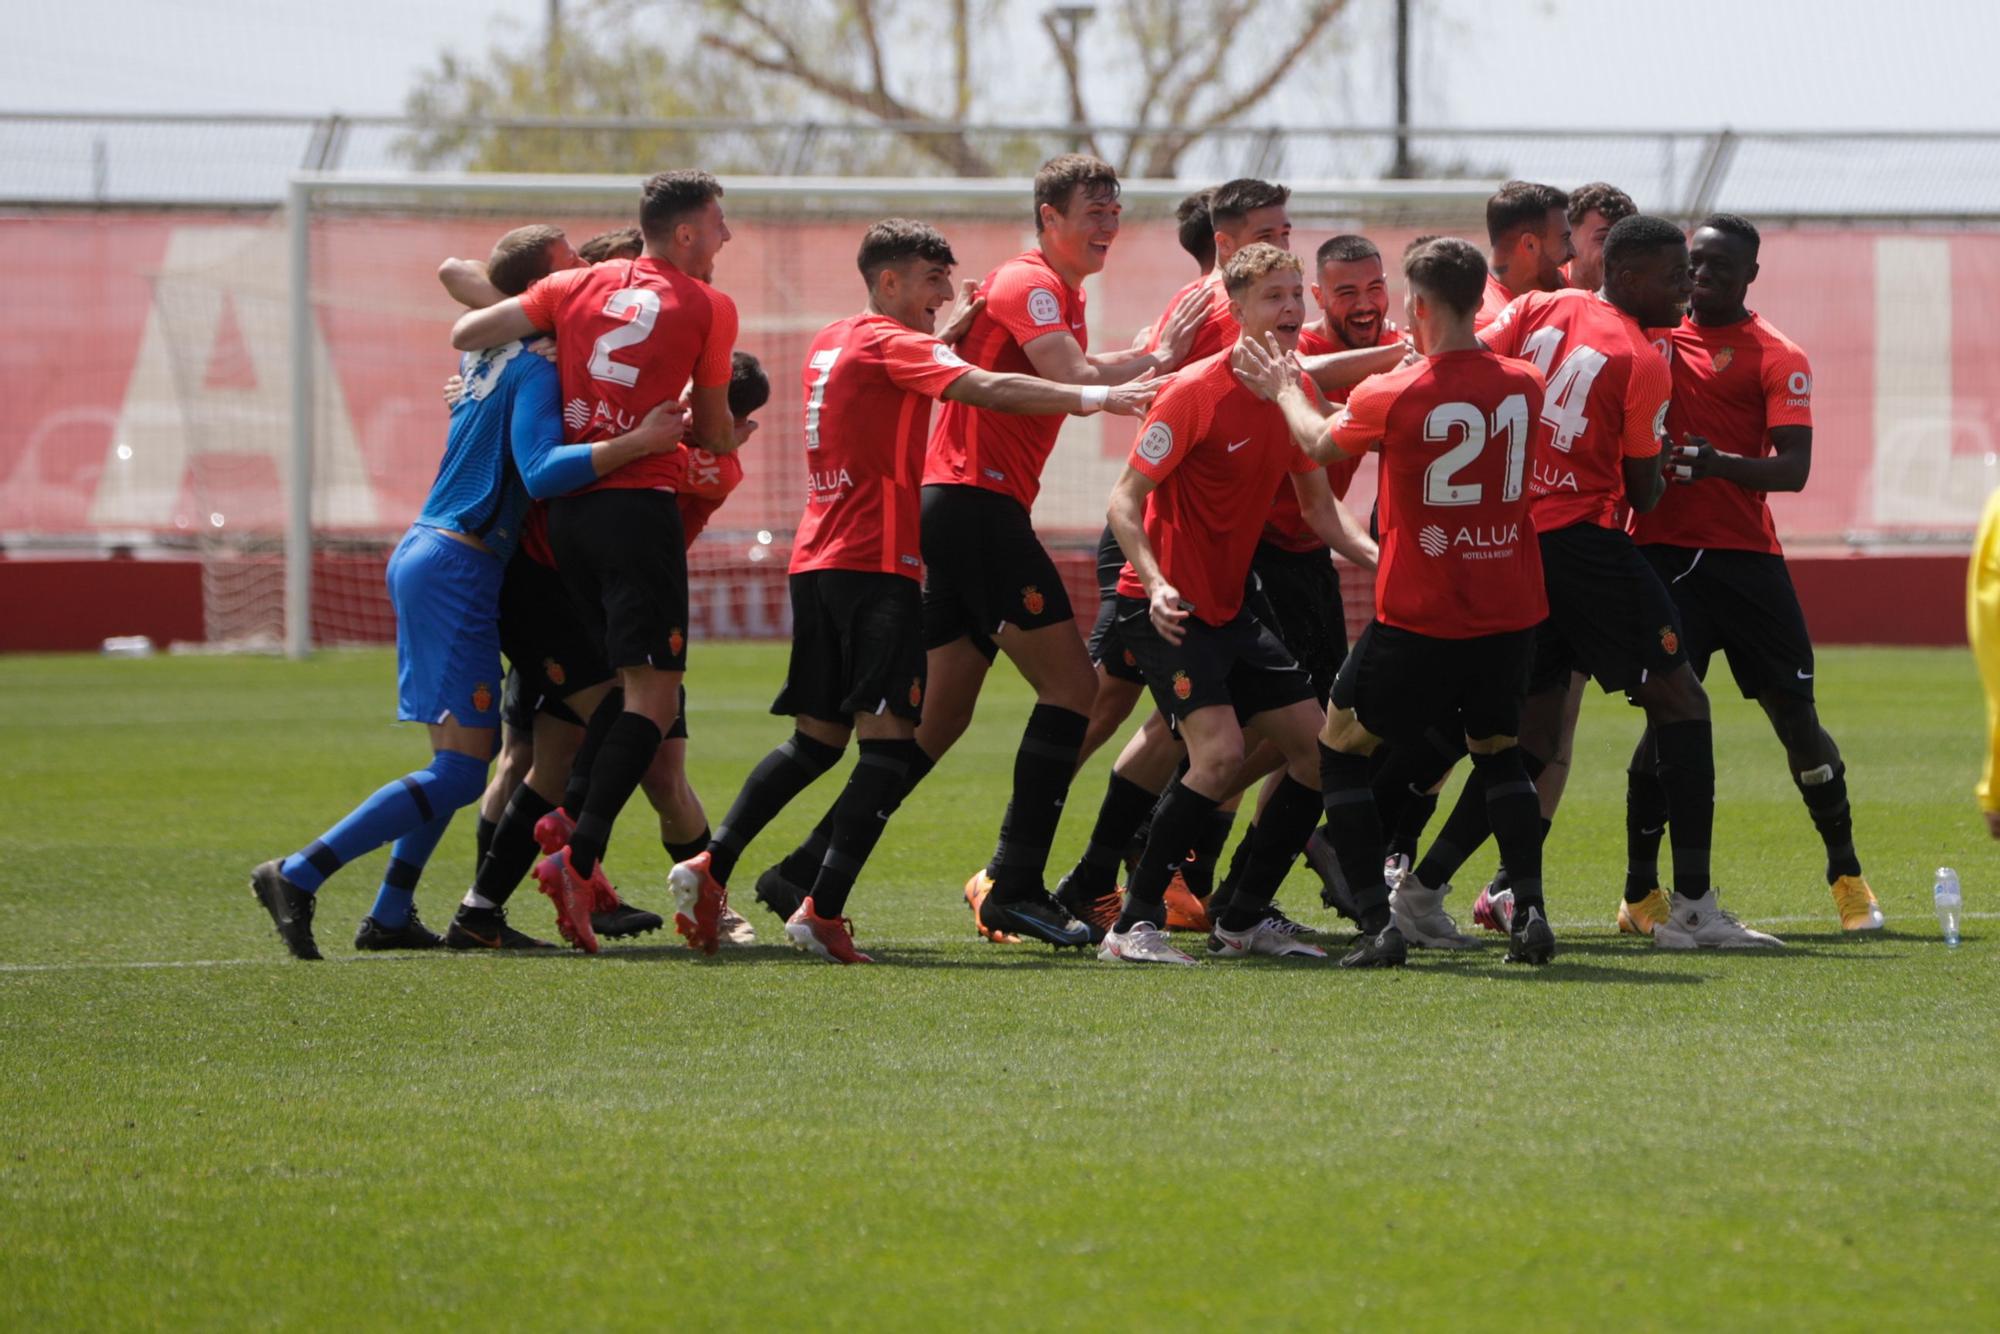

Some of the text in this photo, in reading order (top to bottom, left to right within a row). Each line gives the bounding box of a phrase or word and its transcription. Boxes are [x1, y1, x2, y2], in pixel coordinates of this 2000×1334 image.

[88, 227, 380, 525] A
[587, 288, 660, 388] 2
[805, 347, 842, 448] 7
[1520, 325, 1609, 453] 14
[808, 468, 853, 491] ALUA
[1424, 394, 1528, 506] 21
[1454, 523, 1519, 546] ALUA
[1462, 552, 1487, 560] HOTELS
